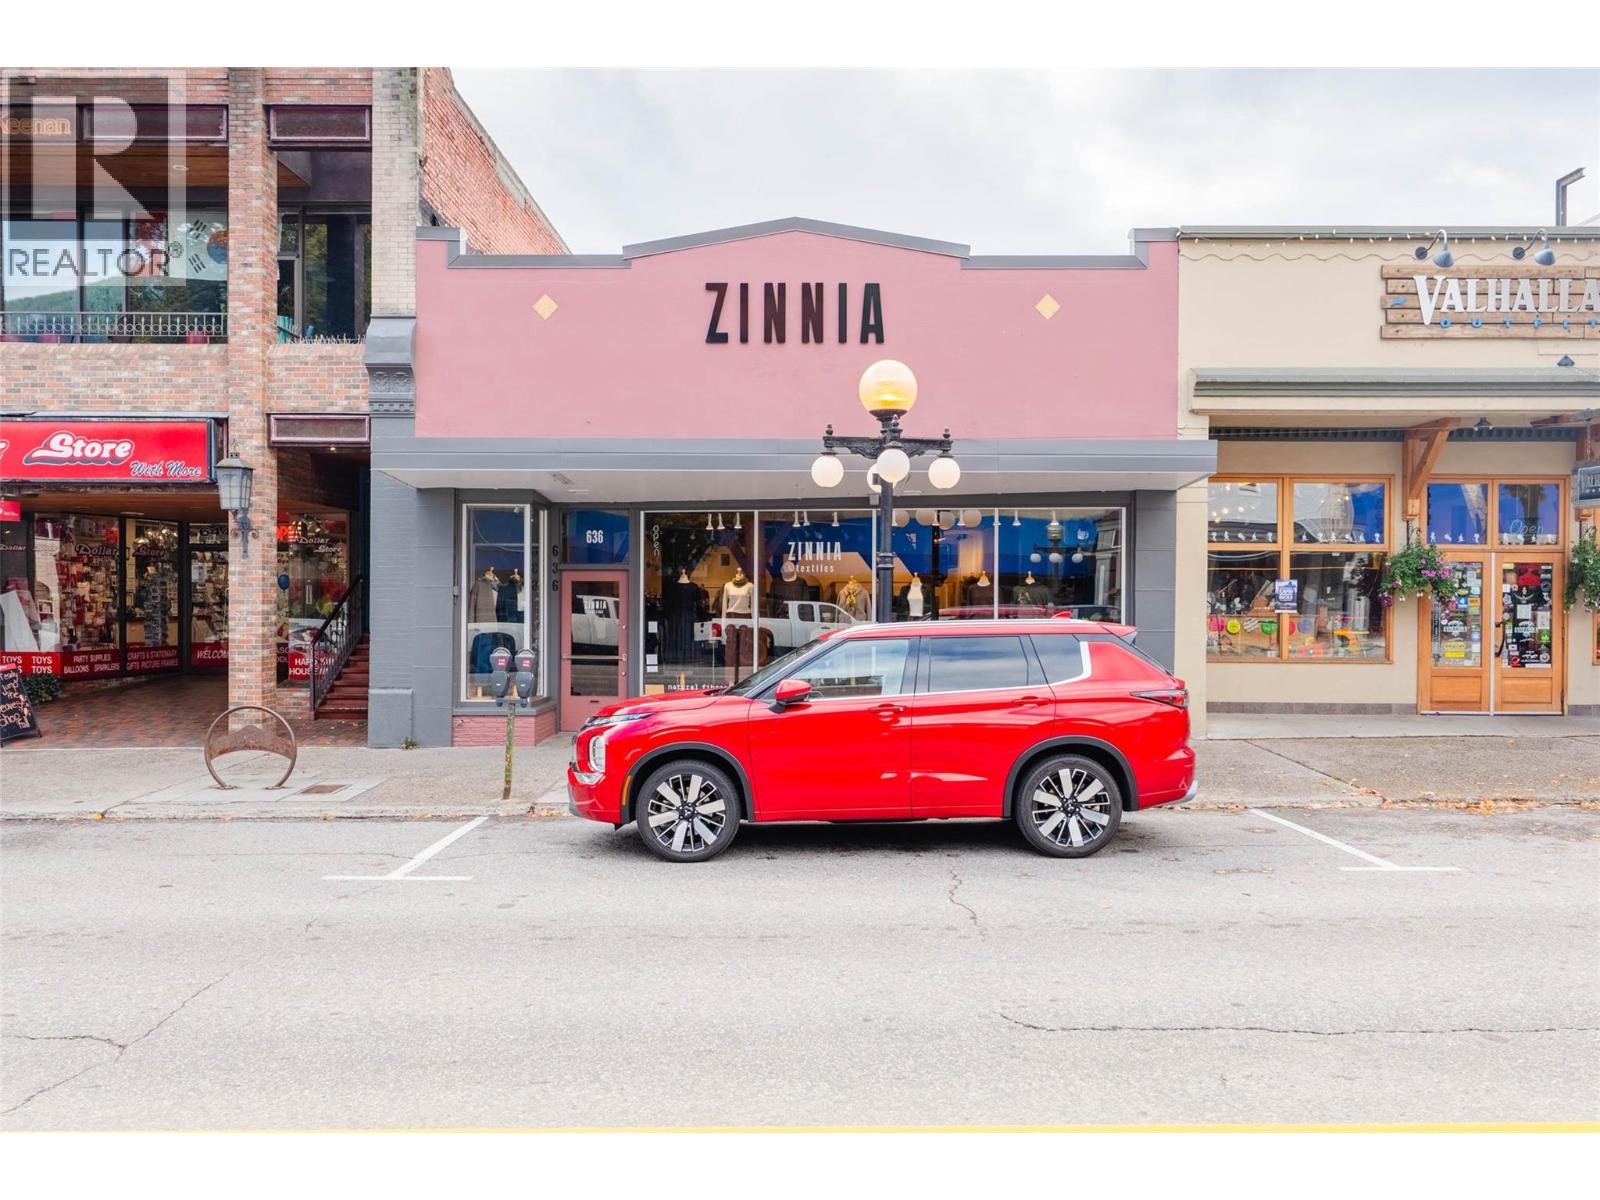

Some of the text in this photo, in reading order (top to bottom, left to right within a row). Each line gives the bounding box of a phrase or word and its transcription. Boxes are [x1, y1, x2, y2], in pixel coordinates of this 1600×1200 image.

[1413, 275, 1600, 326] VALHALLA
[705, 282, 885, 344] ZINNIA
[27, 431, 134, 463] Store
[130, 461, 202, 477] With More
[585, 529, 604, 544] 636
[788, 541, 842, 561] ZINNIA
[2, 655, 53, 664] TOYS TOYS
[73, 653, 112, 663] PARTY SUPPLIES
[32, 665, 53, 674] TOYS
[64, 664, 90, 674] BALLOONS
